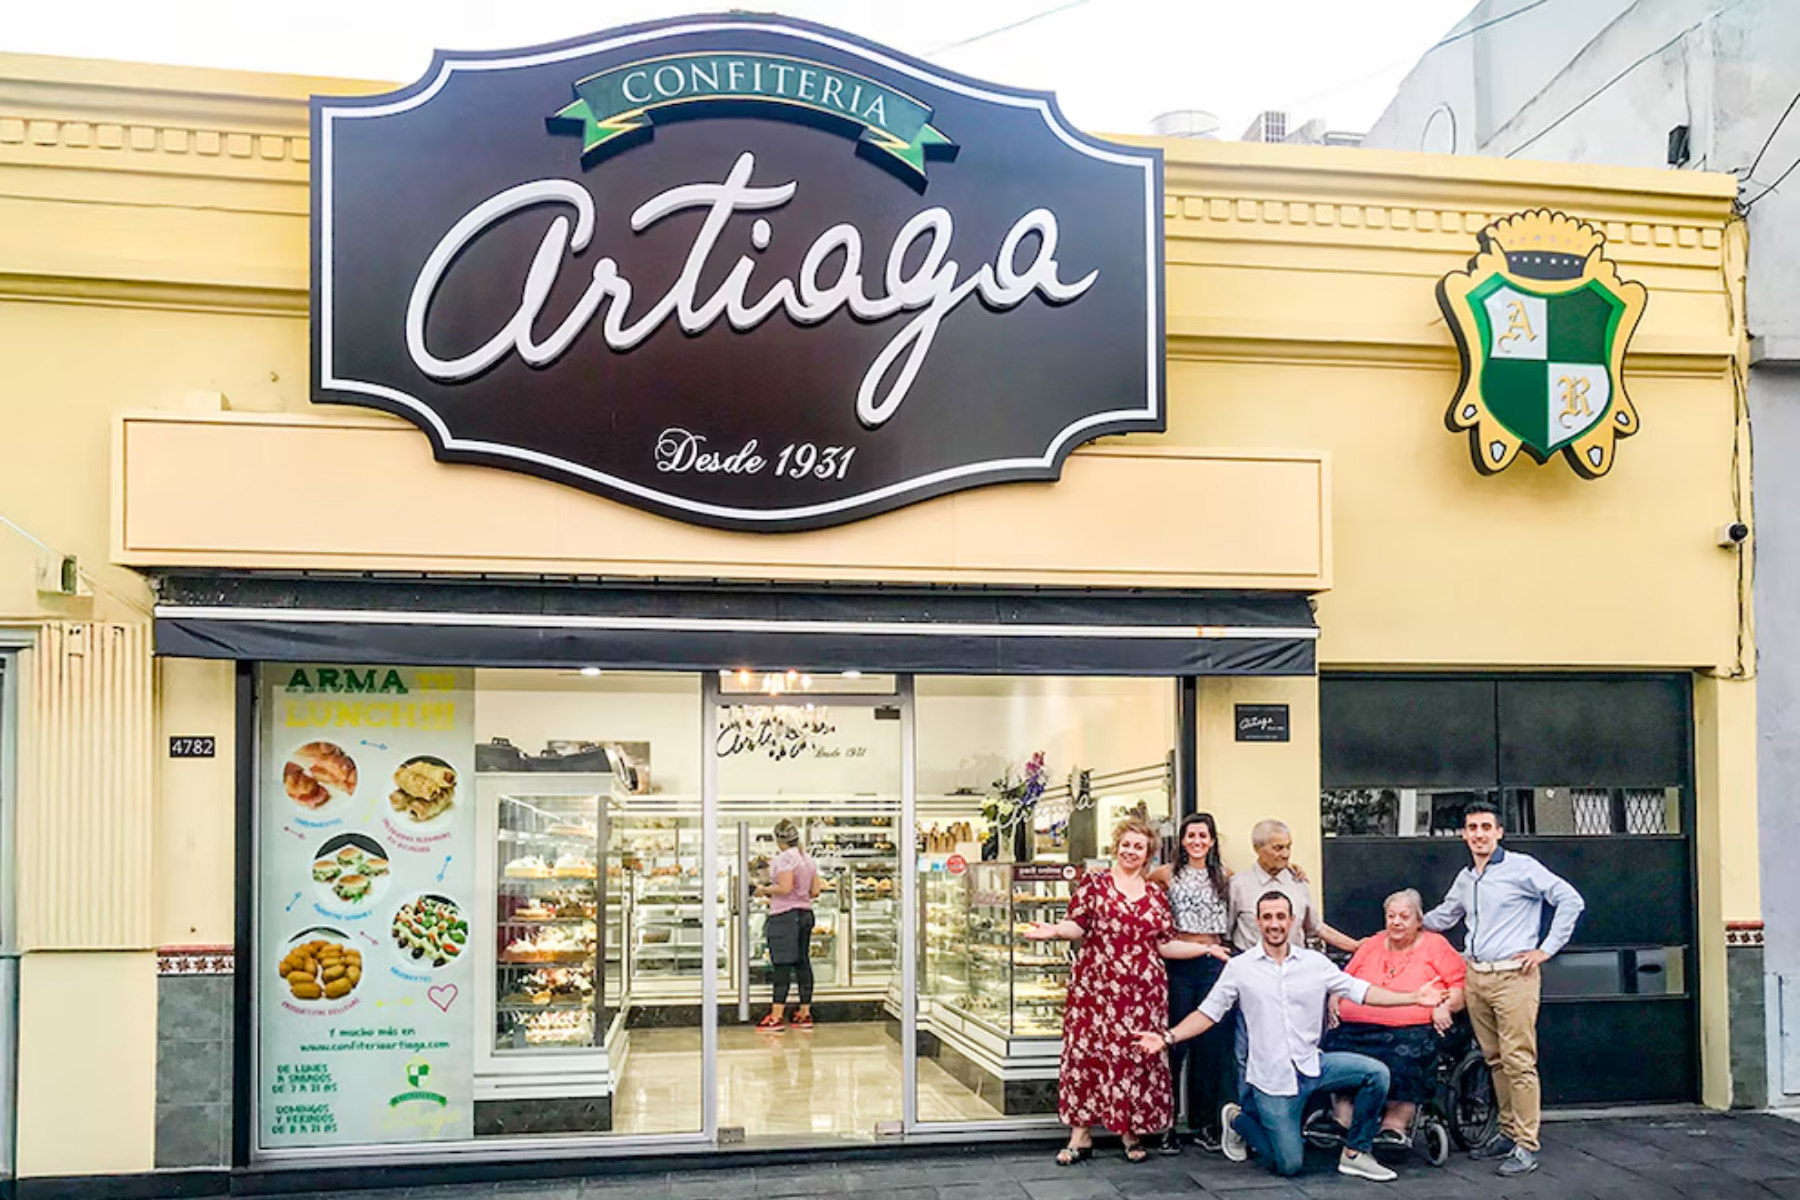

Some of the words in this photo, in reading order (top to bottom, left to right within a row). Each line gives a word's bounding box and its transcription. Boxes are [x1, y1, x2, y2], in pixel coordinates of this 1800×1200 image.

[622, 61, 888, 126] CONFITERIA
[406, 152, 1099, 427] Artiaga
[1497, 301, 1538, 353] A
[1557, 375, 1595, 429] R
[655, 428, 768, 474] Desde
[775, 442, 857, 479] 1931
[284, 668, 409, 694] ARMA
[415, 673, 455, 693] TU
[171, 739, 214, 755] 4782
[339, 1028, 375, 1037] mucho
[401, 1027, 416, 1036] en
[300, 1040, 450, 1053] www.confiteriaartiaga.com
[277, 1064, 290, 1074] DE
[295, 1064, 328, 1073] LUNES
[271, 1084, 284, 1094] DE
[275, 1104, 329, 1114] DOMINGOS
[286, 1113, 335, 1124] FERIADOS
[271, 1125, 284, 1134] DE
